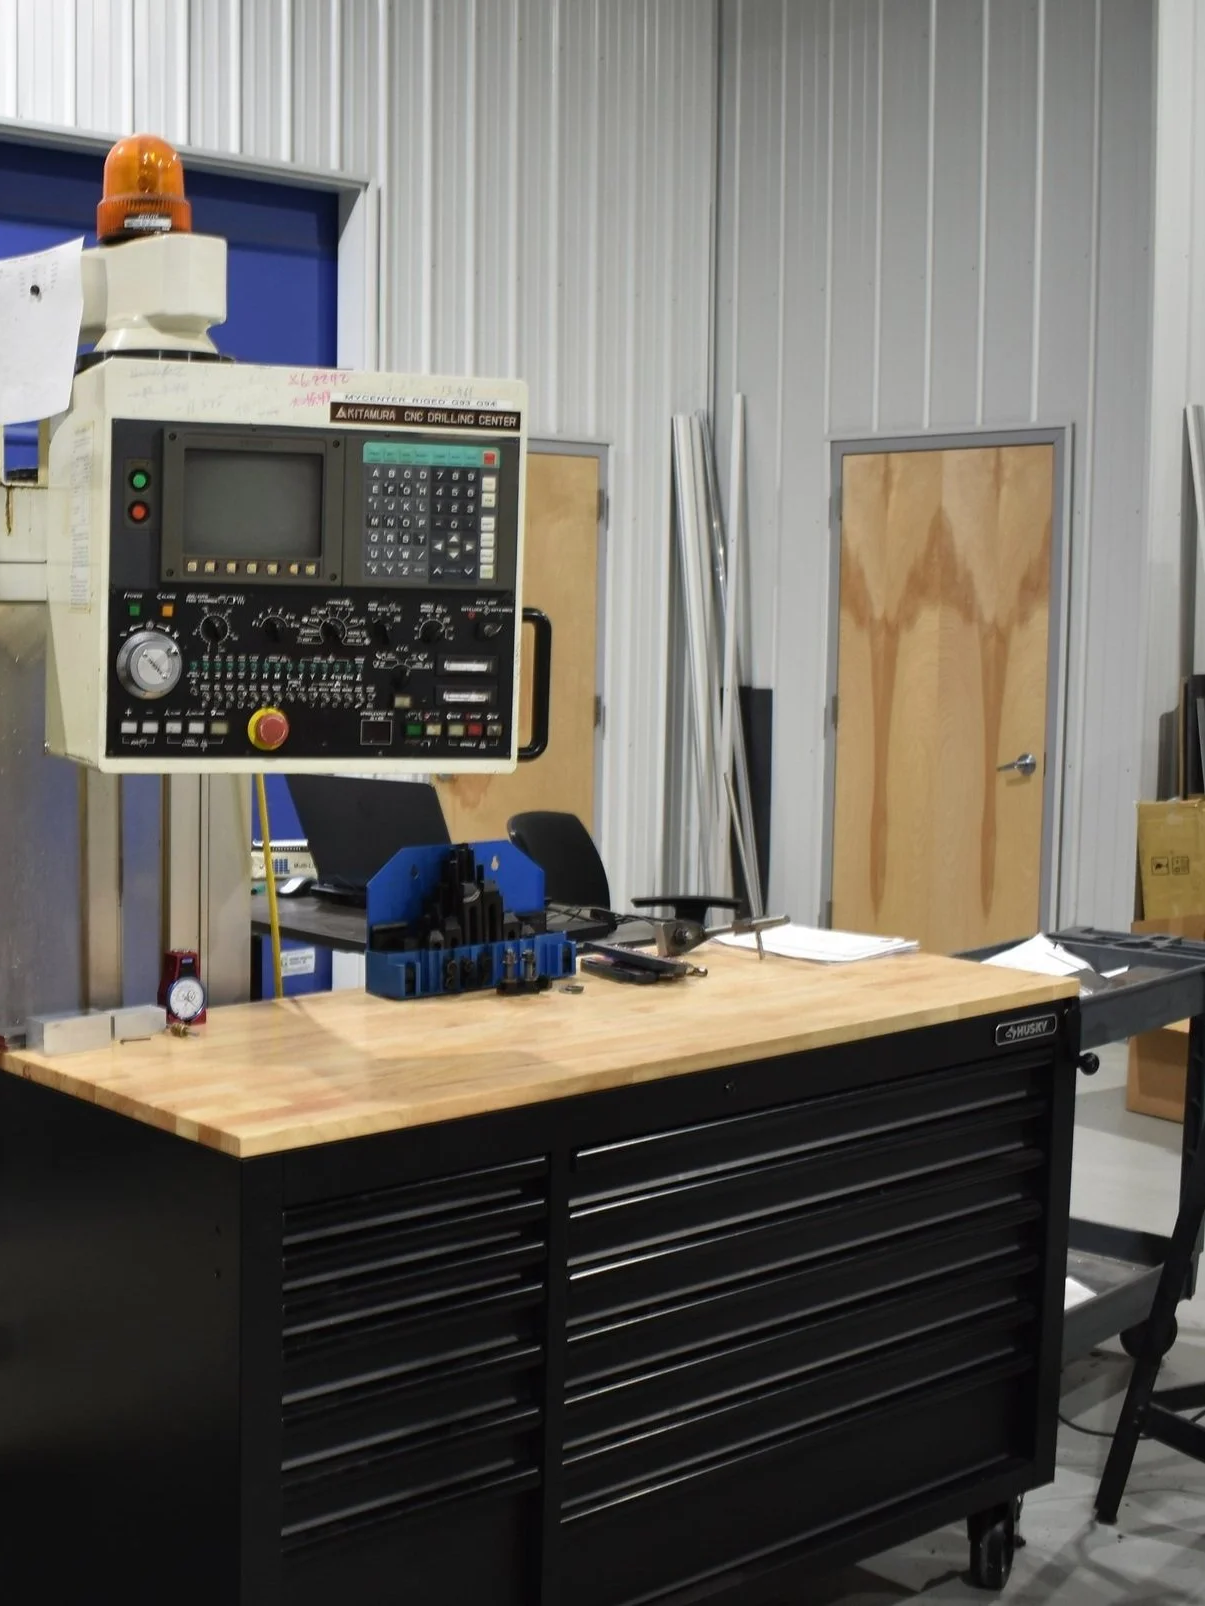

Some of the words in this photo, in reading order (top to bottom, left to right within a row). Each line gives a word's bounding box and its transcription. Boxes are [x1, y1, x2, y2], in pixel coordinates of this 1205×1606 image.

[347, 408, 396, 422] KITAMURA
[404, 411, 423, 422] CNC
[427, 412, 474, 425] DRILLING
[478, 415, 516, 427] CENTER
[1017, 1021, 1048, 1037] HUSKY
